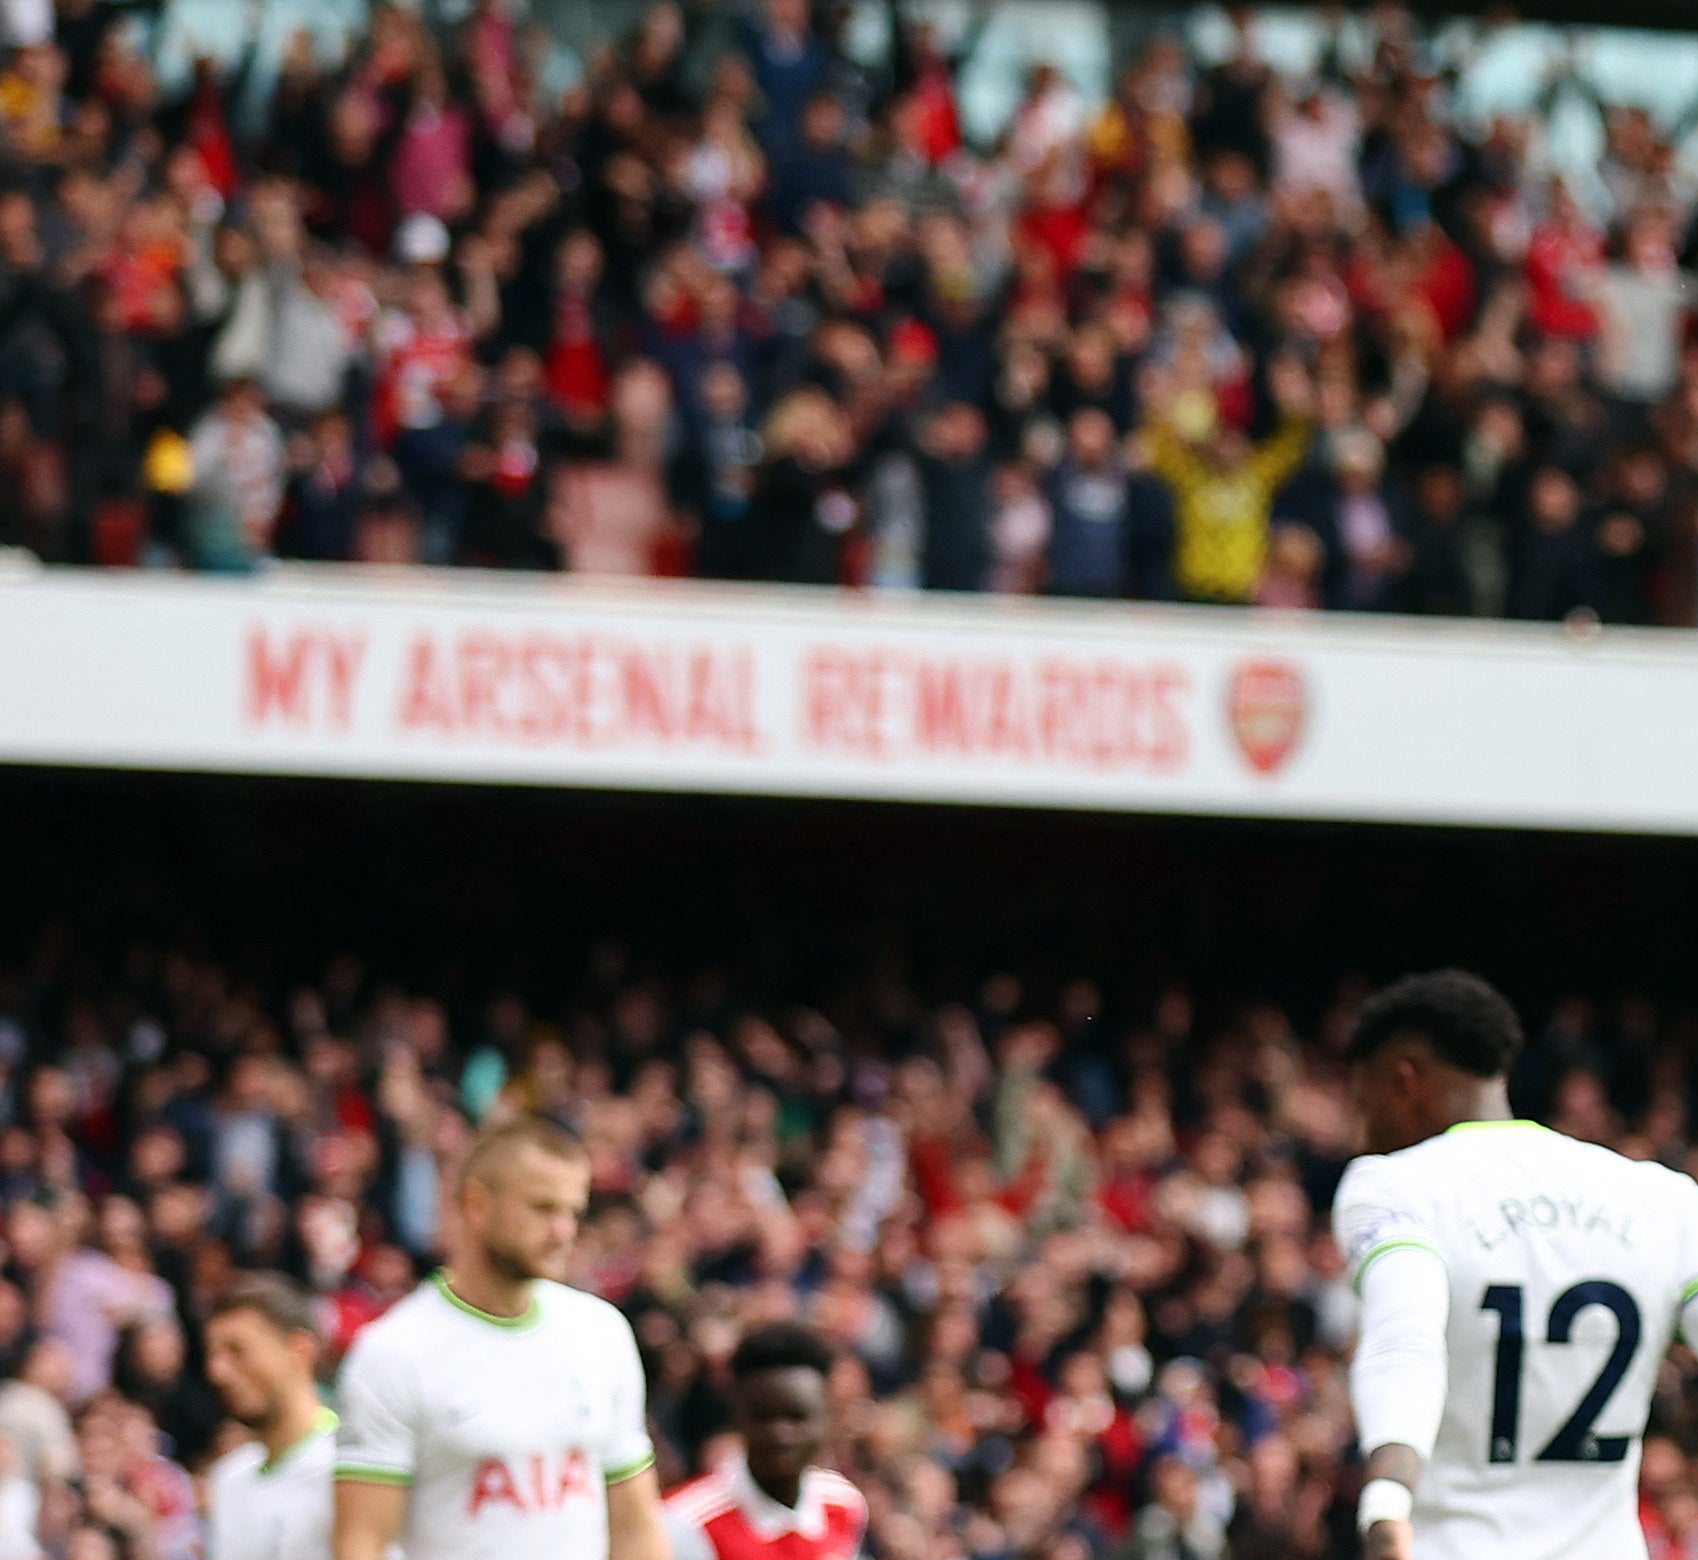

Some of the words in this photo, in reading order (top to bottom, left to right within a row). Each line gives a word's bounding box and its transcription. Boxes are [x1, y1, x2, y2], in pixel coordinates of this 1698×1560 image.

[244, 618, 369, 732] MY
[394, 626, 772, 758] ARSENAL
[801, 643, 1196, 780] REWARDS
[1479, 1279, 1642, 1465] 12
[467, 1449, 599, 1521] AIA
